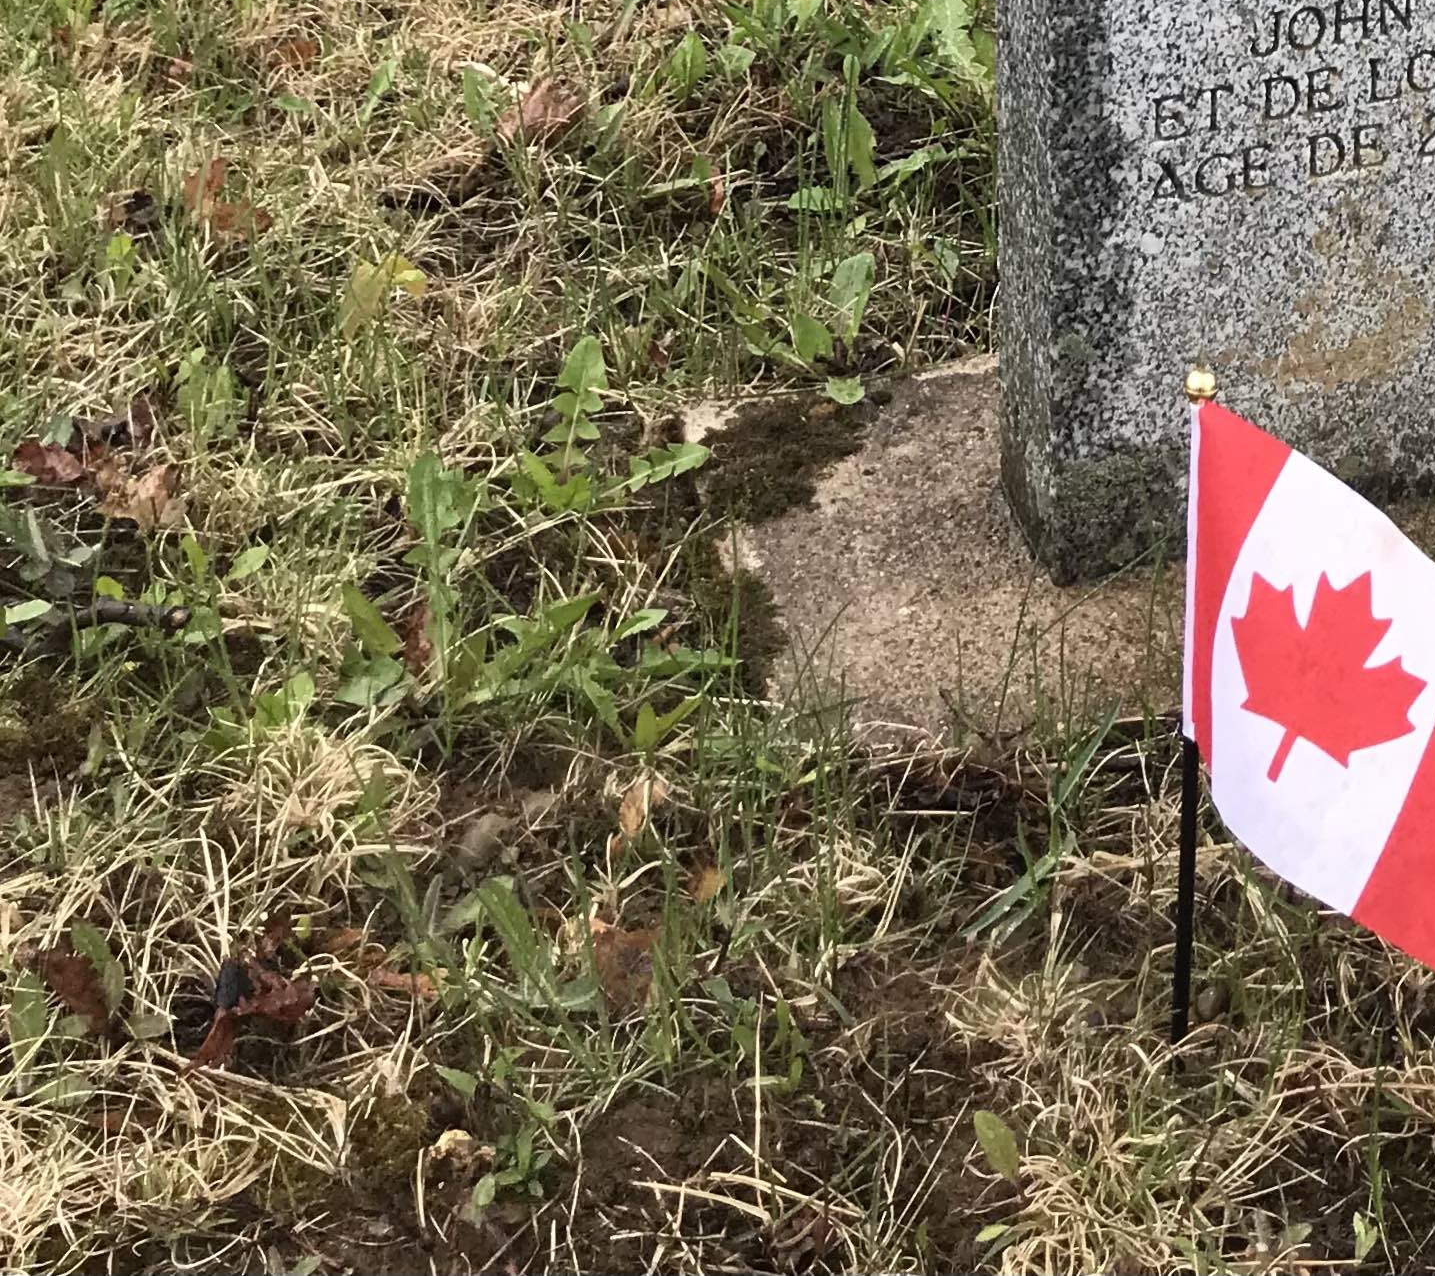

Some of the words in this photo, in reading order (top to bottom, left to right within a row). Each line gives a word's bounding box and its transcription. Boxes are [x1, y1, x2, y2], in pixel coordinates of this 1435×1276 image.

[1151, 84, 1234, 143] ET
[1261, 65, 1346, 121] DE
[1151, 143, 1273, 202] AGE
[1307, 121, 1388, 179] DE
